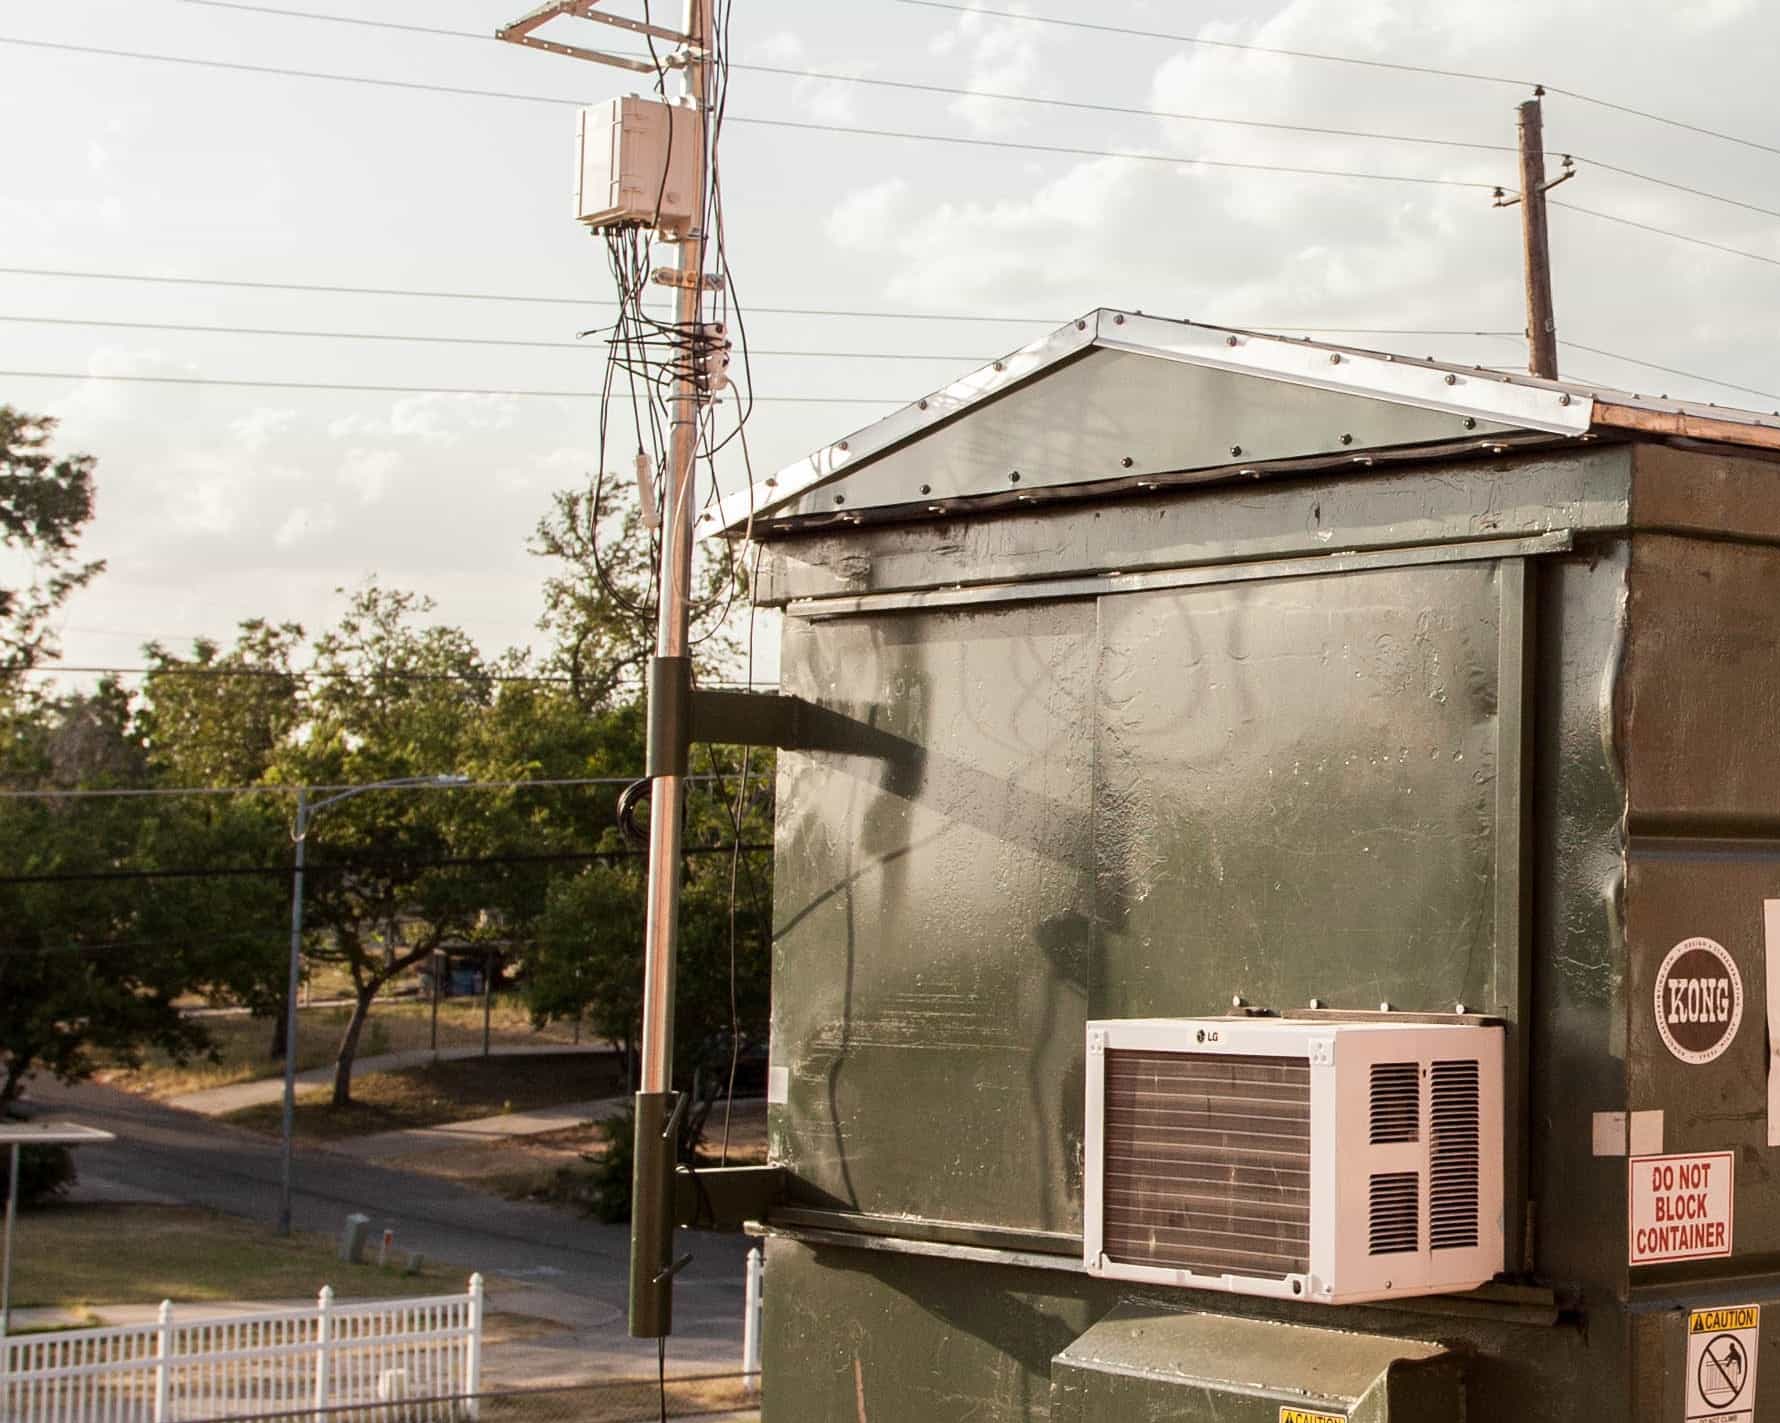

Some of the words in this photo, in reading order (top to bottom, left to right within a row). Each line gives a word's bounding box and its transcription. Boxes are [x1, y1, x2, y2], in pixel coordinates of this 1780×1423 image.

[1667, 977, 1729, 1024] KONG
[1207, 1031, 1219, 1042] LG
[1652, 1165, 1674, 1193] DO
[1679, 1163, 1711, 1190] NOT
[1655, 1193, 1708, 1222] BLOCK
[1636, 1222, 1725, 1254] CONTAINER
[1704, 1309, 1754, 1329] CAUTION
